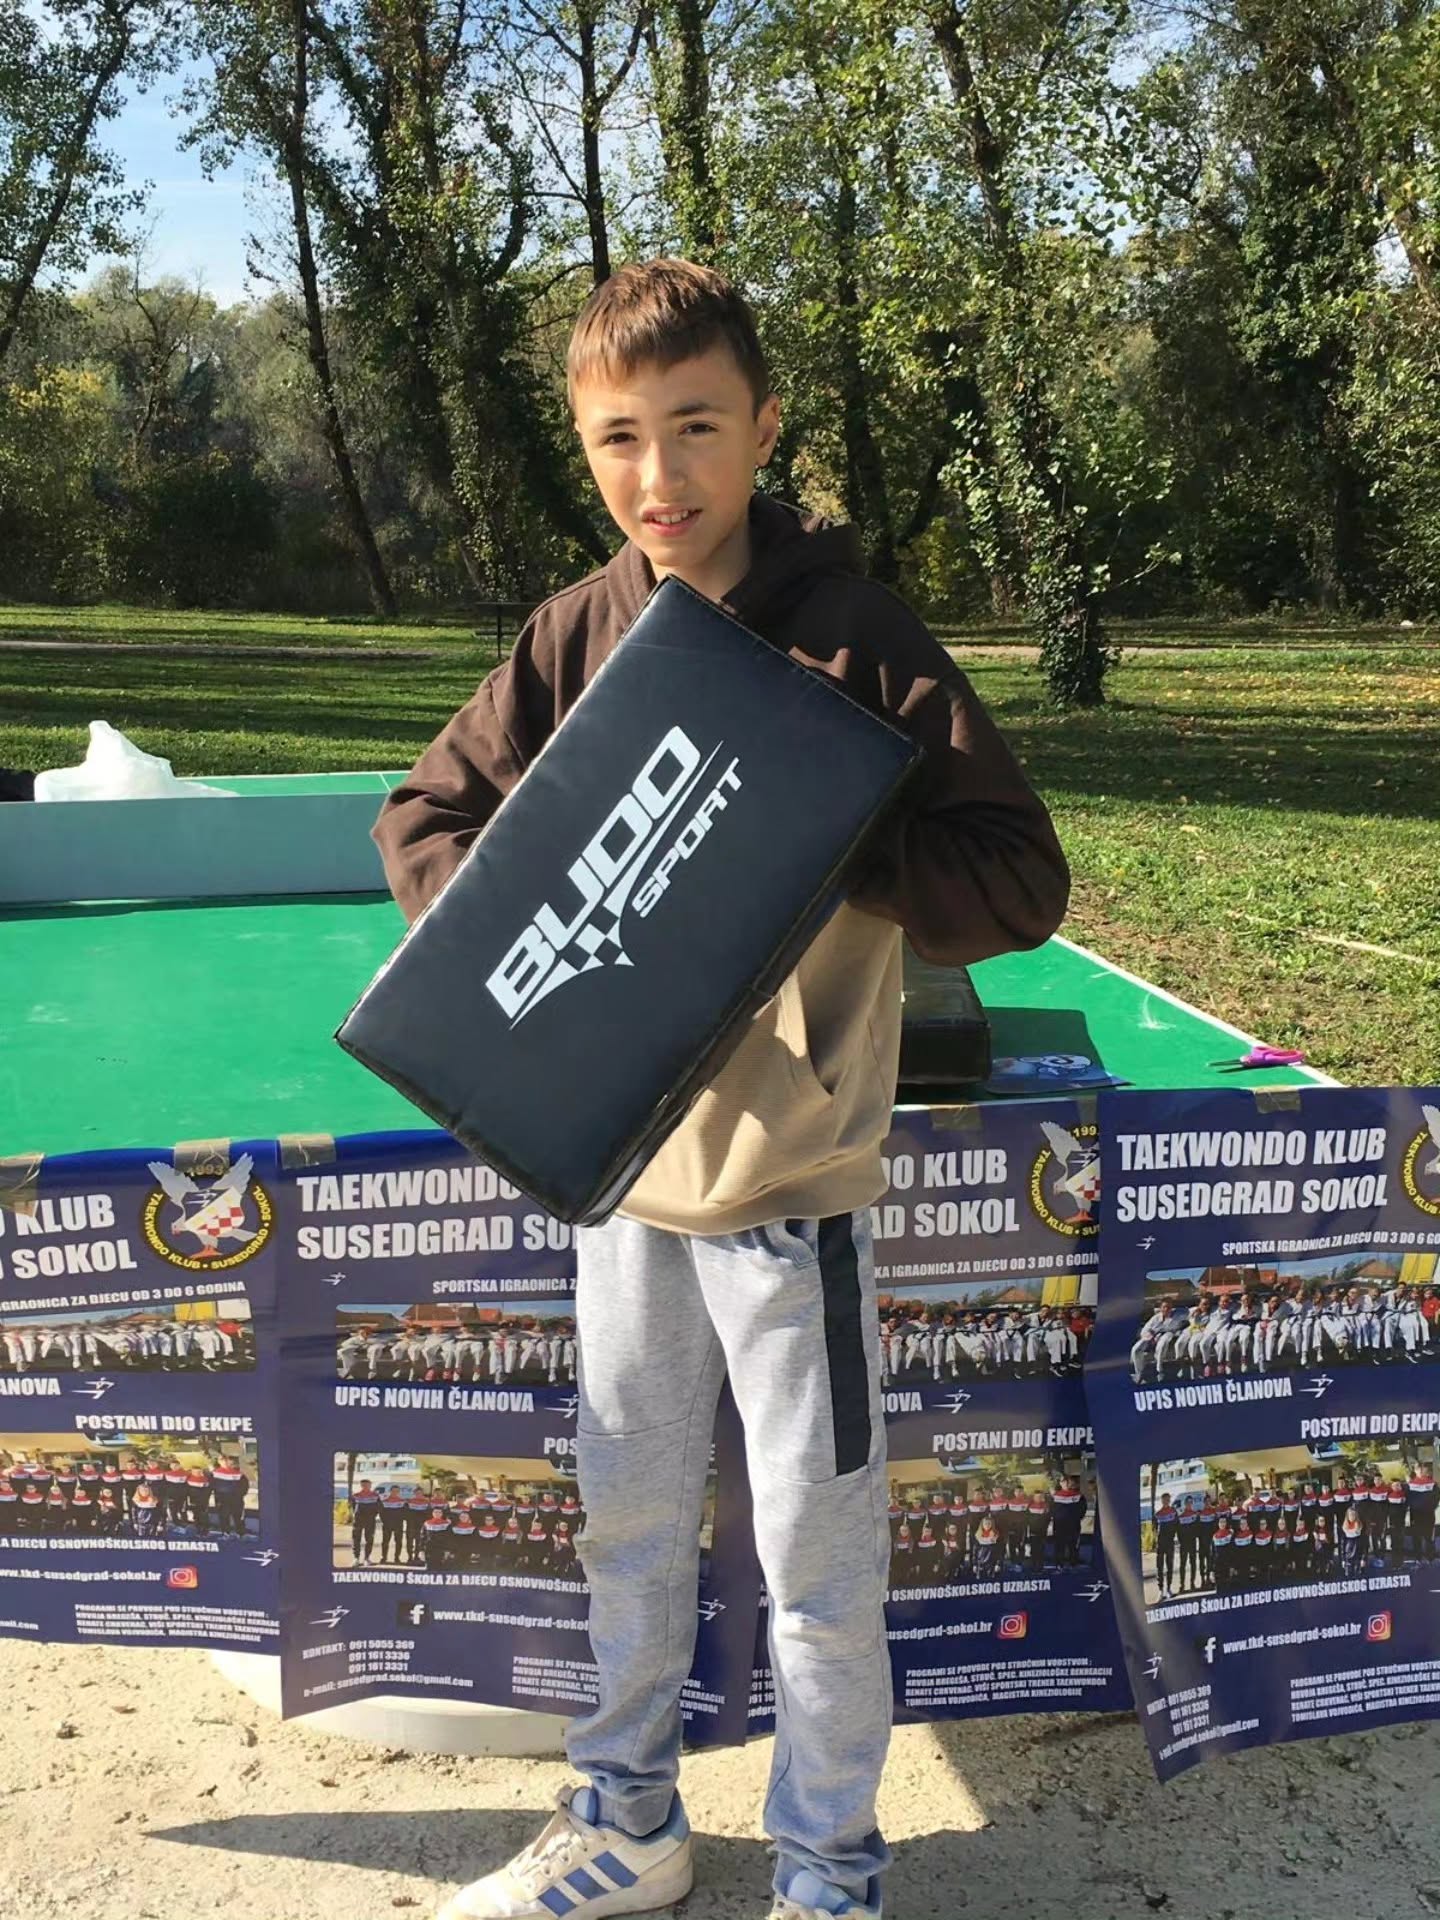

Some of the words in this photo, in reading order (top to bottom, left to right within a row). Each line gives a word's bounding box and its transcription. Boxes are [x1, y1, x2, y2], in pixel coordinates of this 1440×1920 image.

[631, 757, 742, 918] SPORT
[485, 725, 701, 1019] BUDO
[1073, 1126, 1098, 1137] 199
[1116, 1130, 1307, 1171] TAEKWONDO
[1312, 1127, 1387, 1165] KLUB
[1403, 1131, 1429, 1196] TAEKWONDO
[924, 1148, 1007, 1188] KLUB
[1031, 1149, 1051, 1218] TAEKWONDO
[1046, 1216, 1074, 1235] KLUB
[1116, 1179, 1295, 1223] SUSEDGRAD
[1301, 1174, 1388, 1214] SOKOL
[1413, 1195, 1439, 1215] KLUB
[14, 1194, 115, 1236] KLUB
[145, 1193, 169, 1255] TAEKWONDO
[168, 1253, 200, 1269] KLUB
[211, 1229, 268, 1269] SUSEDGRAD
[252, 1185, 272, 1221] SOKOL
[914, 1199, 1020, 1239] SOKOL
[297, 1215, 513, 1260] SUSEDGRAD
[1222, 1240, 1275, 1256] SPORTSKA
[1277, 1237, 1330, 1252] IGRAONICA
[1331, 1235, 1343, 1247] ZA
[1343, 1231, 1371, 1246] DJECU
[1373, 1231, 1389, 1243] OD
[1389, 1232, 1398, 1243] 3
[1399, 1232, 1415, 1244] DO
[1416, 1232, 1425, 1244] 6
[11, 1239, 137, 1279] SOKOL
[892, 1262, 955, 1278] IGRAONICA
[957, 1261, 971, 1273] ZA
[972, 1258, 1007, 1273] DJECU
[1010, 1257, 1025, 1270] OD
[1027, 1256, 1036, 1269] 3
[1038, 1255, 1053, 1268] DO
[1055, 1254, 1064, 1267] 6
[0, 1297, 69, 1311] GRAONICA
[71, 1296, 87, 1306] ZA
[89, 1290, 129, 1304] DJECU
[131, 1289, 150, 1301] OD
[152, 1289, 162, 1299] 3
[164, 1287, 182, 1298] DO
[185, 1286, 194, 1297] 6
[196, 1281, 246, 1296] GODINA
[432, 1279, 498, 1294] SPORTSKA
[500, 1277, 567, 1292] IGRAONICA
[0, 1378, 61, 1395] ANOVA
[335, 1386, 380, 1407] UPIS
[384, 1387, 444, 1410] NOVIH
[448, 1386, 535, 1413] ČLANOVA
[1133, 1388, 1173, 1412] UPIS
[1175, 1383, 1223, 1408] NOVIH
[1226, 1377, 1293, 1403] ČLANOVA
[75, 1415, 157, 1431] POSTANI
[162, 1416, 195, 1431] DIO
[200, 1416, 253, 1432] EKIPE
[1301, 1415, 1367, 1439] POSTANI
[1369, 1414, 1399, 1434] DIO
[1402, 1412, 1440, 1432] EKIP
[932, 1430, 1008, 1453] POSTANI
[1012, 1429, 1043, 1448] DIO
[11, 1538, 47, 1549] DJECU
[168, 1541, 219, 1553] UZRASTA
[332, 1572, 404, 1585] TAEKWONDO
[406, 1571, 443, 1586] ŠKOLA
[445, 1575, 460, 1586] ZA
[461, 1575, 497, 1587] DJECU
[499, 1577, 590, 1594] OSNOVNOŠKOLS
[892, 1582, 1001, 1602] OSNOVNOŠKOLSKOG
[1003, 1579, 1051, 1593] UZRASTA
[1145, 1603, 1199, 1624] TAEKWONDO
[1200, 1597, 1230, 1614] ŠKOLA
[1231, 1595, 1243, 1609] ZA
[1244, 1591, 1272, 1607] DJECU
[1273, 1578, 1367, 1602] OSNOVNOŠKOLSKOG
[1368, 1574, 1411, 1590] UZRASTA
[349, 1640, 367, 1651] 091
